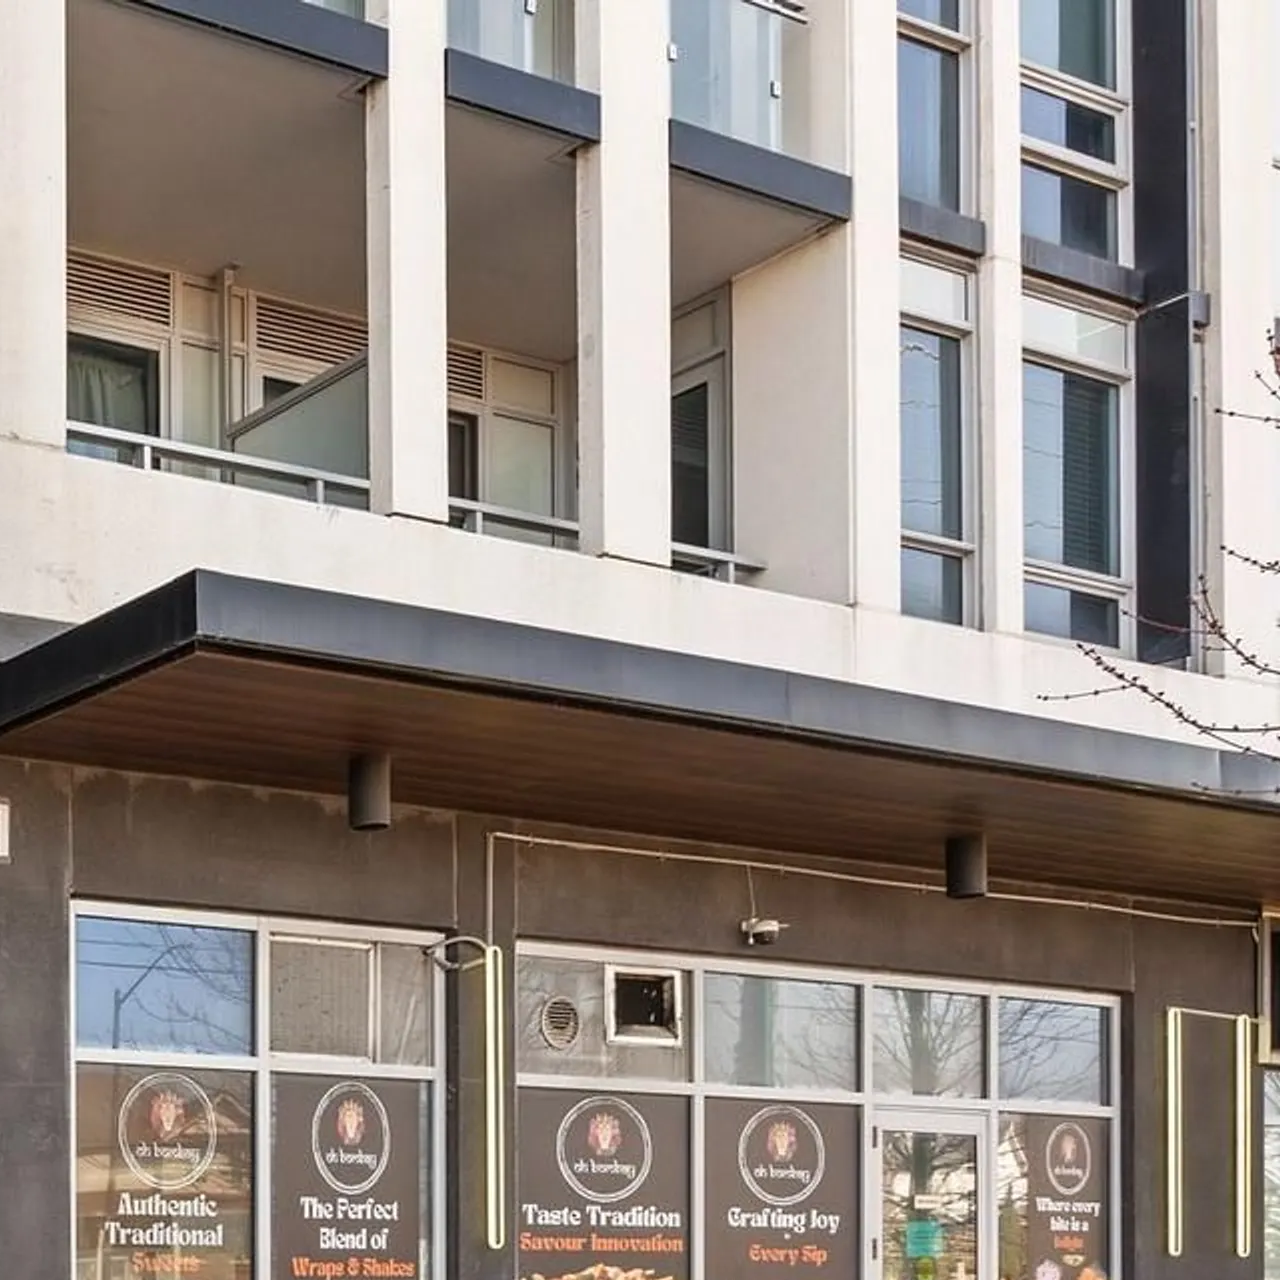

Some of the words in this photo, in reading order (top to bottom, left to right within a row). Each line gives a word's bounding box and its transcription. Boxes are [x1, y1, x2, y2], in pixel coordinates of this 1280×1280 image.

[117, 1192, 218, 1217] Authentic
[300, 1196, 334, 1220] The
[337, 1198, 399, 1221] Perfect
[522, 1204, 582, 1226] Taste
[586, 1205, 681, 1227] Tradition
[728, 1207, 807, 1233] Crafting
[810, 1209, 840, 1234] Joy
[104, 1221, 224, 1247] Traditional
[319, 1227, 367, 1250] Blend
[370, 1228, 389, 1250] of
[519, 1232, 587, 1251] Savour
[591, 1233, 684, 1252] Innovation
[749, 1244, 800, 1265] Every
[291, 1257, 344, 1280] Wraps
[363, 1258, 416, 1277] Shakes
